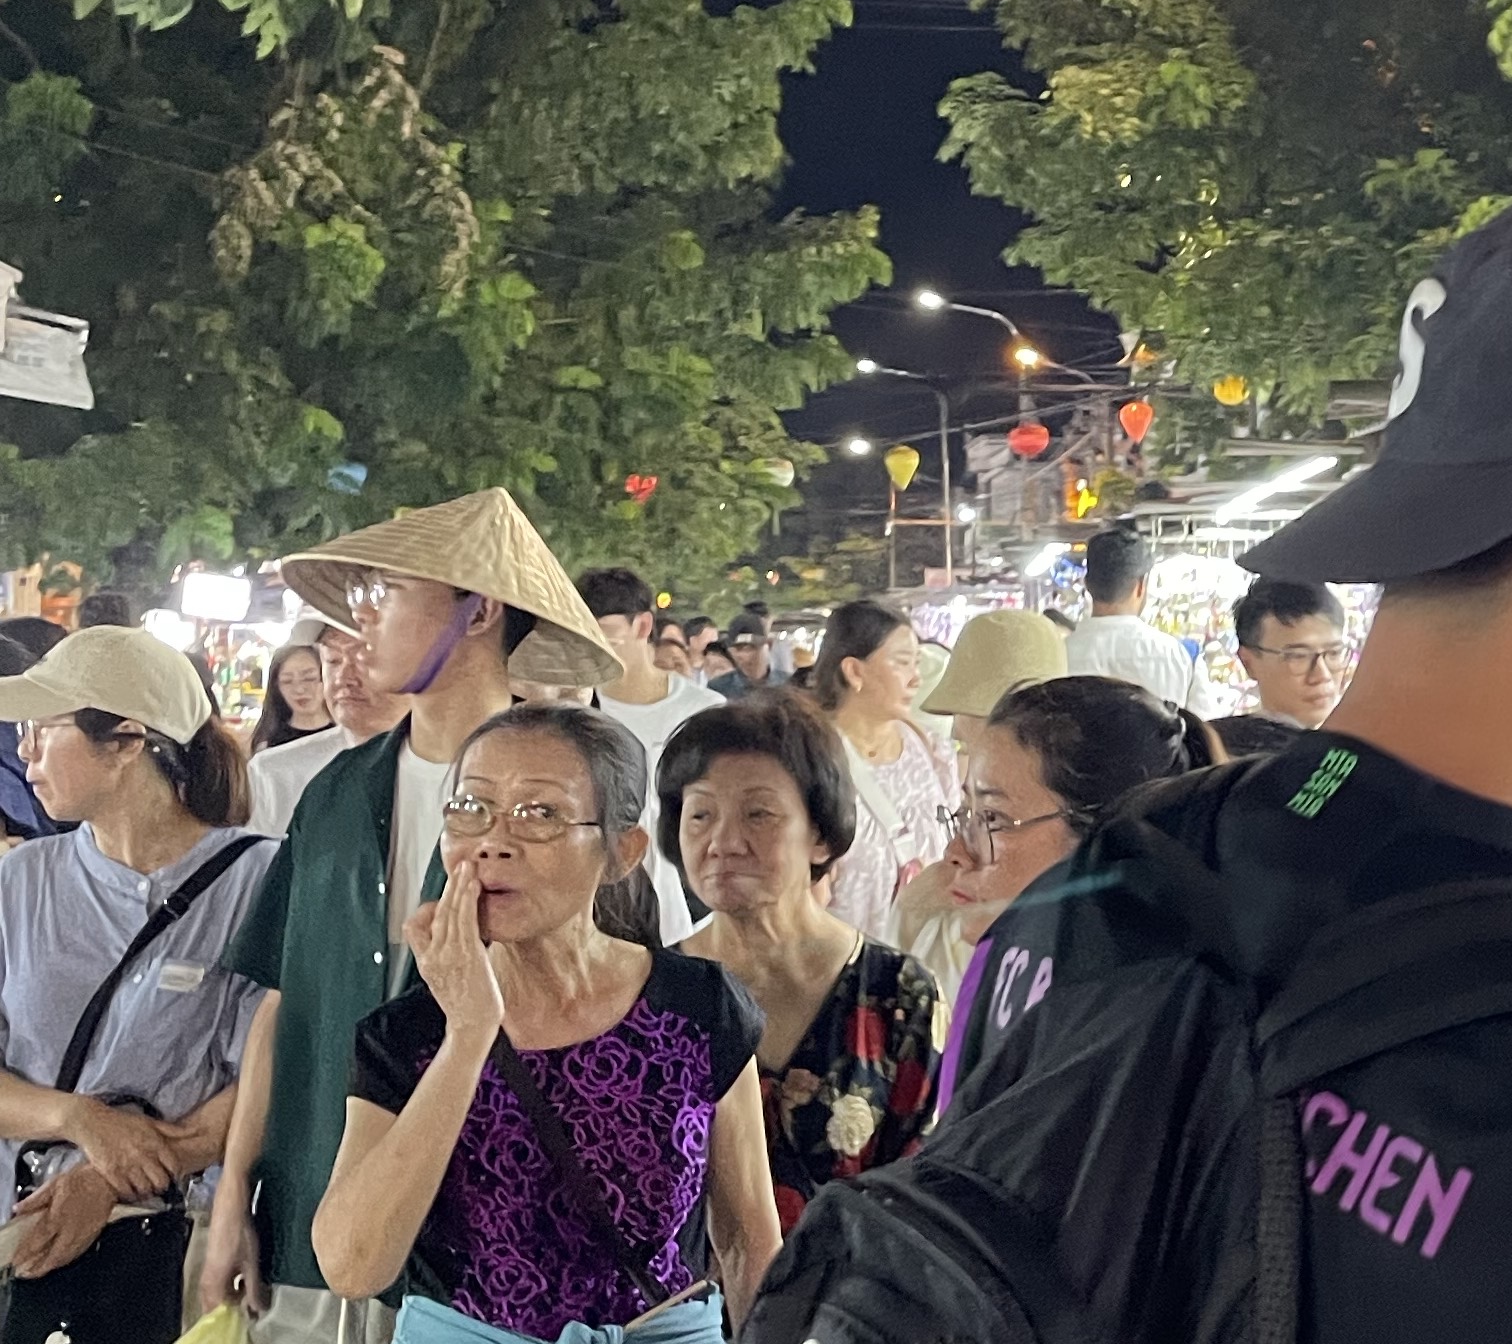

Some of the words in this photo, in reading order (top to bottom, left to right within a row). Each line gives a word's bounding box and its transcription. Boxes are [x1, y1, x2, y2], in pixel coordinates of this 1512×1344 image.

[1320, 748, 1358, 777] MIA
[1302, 769, 1342, 798] SAN
[1285, 789, 1325, 818] MIA
[1301, 1090, 1473, 1259] CHEN
